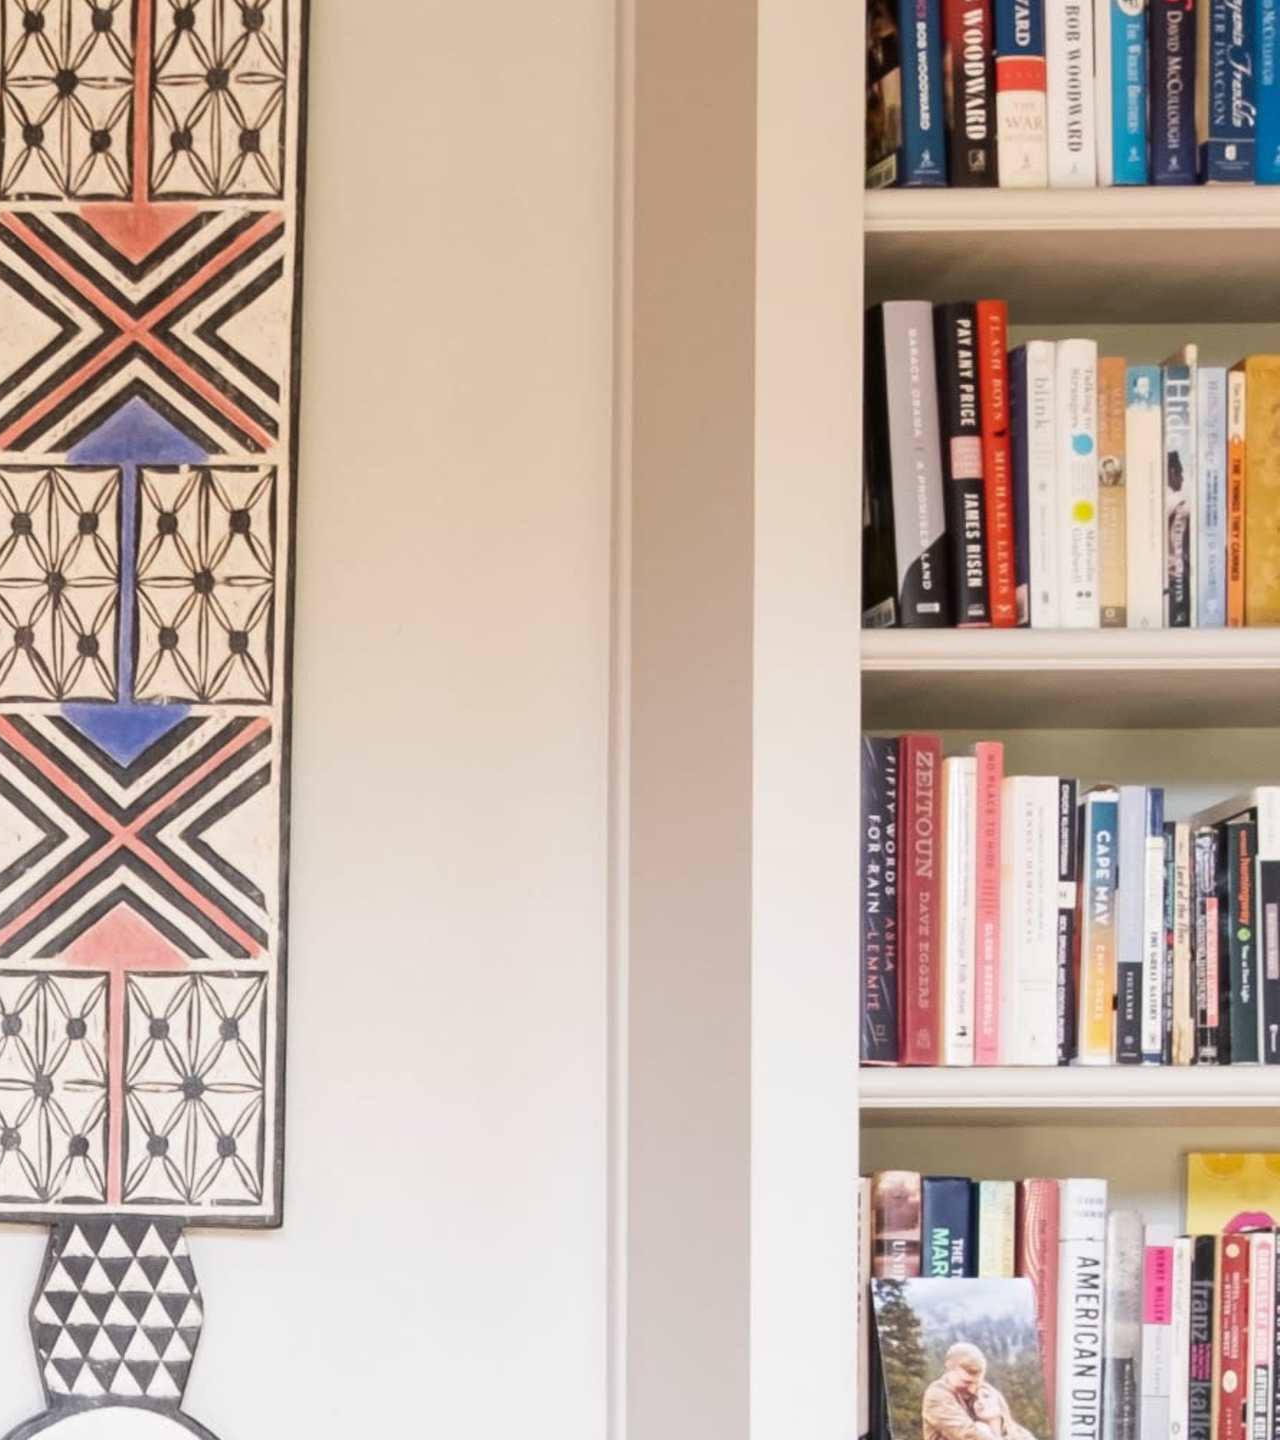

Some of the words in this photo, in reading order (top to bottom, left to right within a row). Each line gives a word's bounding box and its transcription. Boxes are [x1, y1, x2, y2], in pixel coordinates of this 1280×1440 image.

[916, 21, 929, 49] BOB
[1065, 4, 1081, 42] BOB
[1166, 10, 1181, 53] DAVID
[917, 51, 931, 131] WOODWARD
[962, 8, 986, 140] WOODWARD
[1214, 40, 1227, 125] ISAACSON
[1228, 43, 1257, 128] Franklin
[1066, 48, 1082, 153] WOODWARD
[1167, 55, 1183, 149] McCULLOUGH
[956, 319, 971, 347] PAY
[989, 315, 1000, 370] FLASH
[907, 328, 919, 383] BARACK
[957, 350, 972, 381] ANY
[959, 384, 976, 427] PRICE
[992, 379, 1003, 420] BOYS
[1034, 376, 1050, 429] blink
[1083, 368, 1095, 411] Talking
[911, 389, 922, 437] OBAMA
[917, 474, 929, 547] PROMISED
[994, 450, 1007, 532] MICHAEL
[963, 493, 980, 539] JAMES
[1232, 515, 1241, 538] THEY
[921, 552, 932, 590] LAND
[967, 544, 983, 588] RISEN
[997, 540, 1010, 595] LEWIS
[885, 754, 896, 812] FIFTY
[986, 754, 997, 771] NO
[914, 750, 933, 879] ZEITOUN
[986, 774, 997, 816] PLACE
[867, 814, 881, 852] FOR
[986, 818, 997, 838] TO
[884, 822, 896, 896] WORDS
[986, 841, 997, 869] HIDE
[1095, 829, 1111, 878] CAPE
[1176, 865, 1187, 886] Lord
[867, 863, 880, 914] RAIN
[1095, 887, 1110, 926] MAY
[918, 892, 930, 936] DAVE
[1178, 903, 1188, 919] the
[1178, 920, 1189, 945] Flies
[884, 916, 896, 971] ASHA
[866, 931, 880, 1011] LEMMIE
[918, 943, 930, 1009] EGGERS
[1150, 952, 1158, 981] GREAT
[952, 1237, 964, 1264] THE
[1154, 1249, 1165, 1281] HENRY
[1074, 1256, 1100, 1378] AMERICAN
[1153, 1286, 1164, 1322] MILLER
[1191, 1279, 1214, 1341] franz
[1255, 1368, 1268, 1412] ARTHUR
[1071, 1388, 1097, 1440] DIRT
